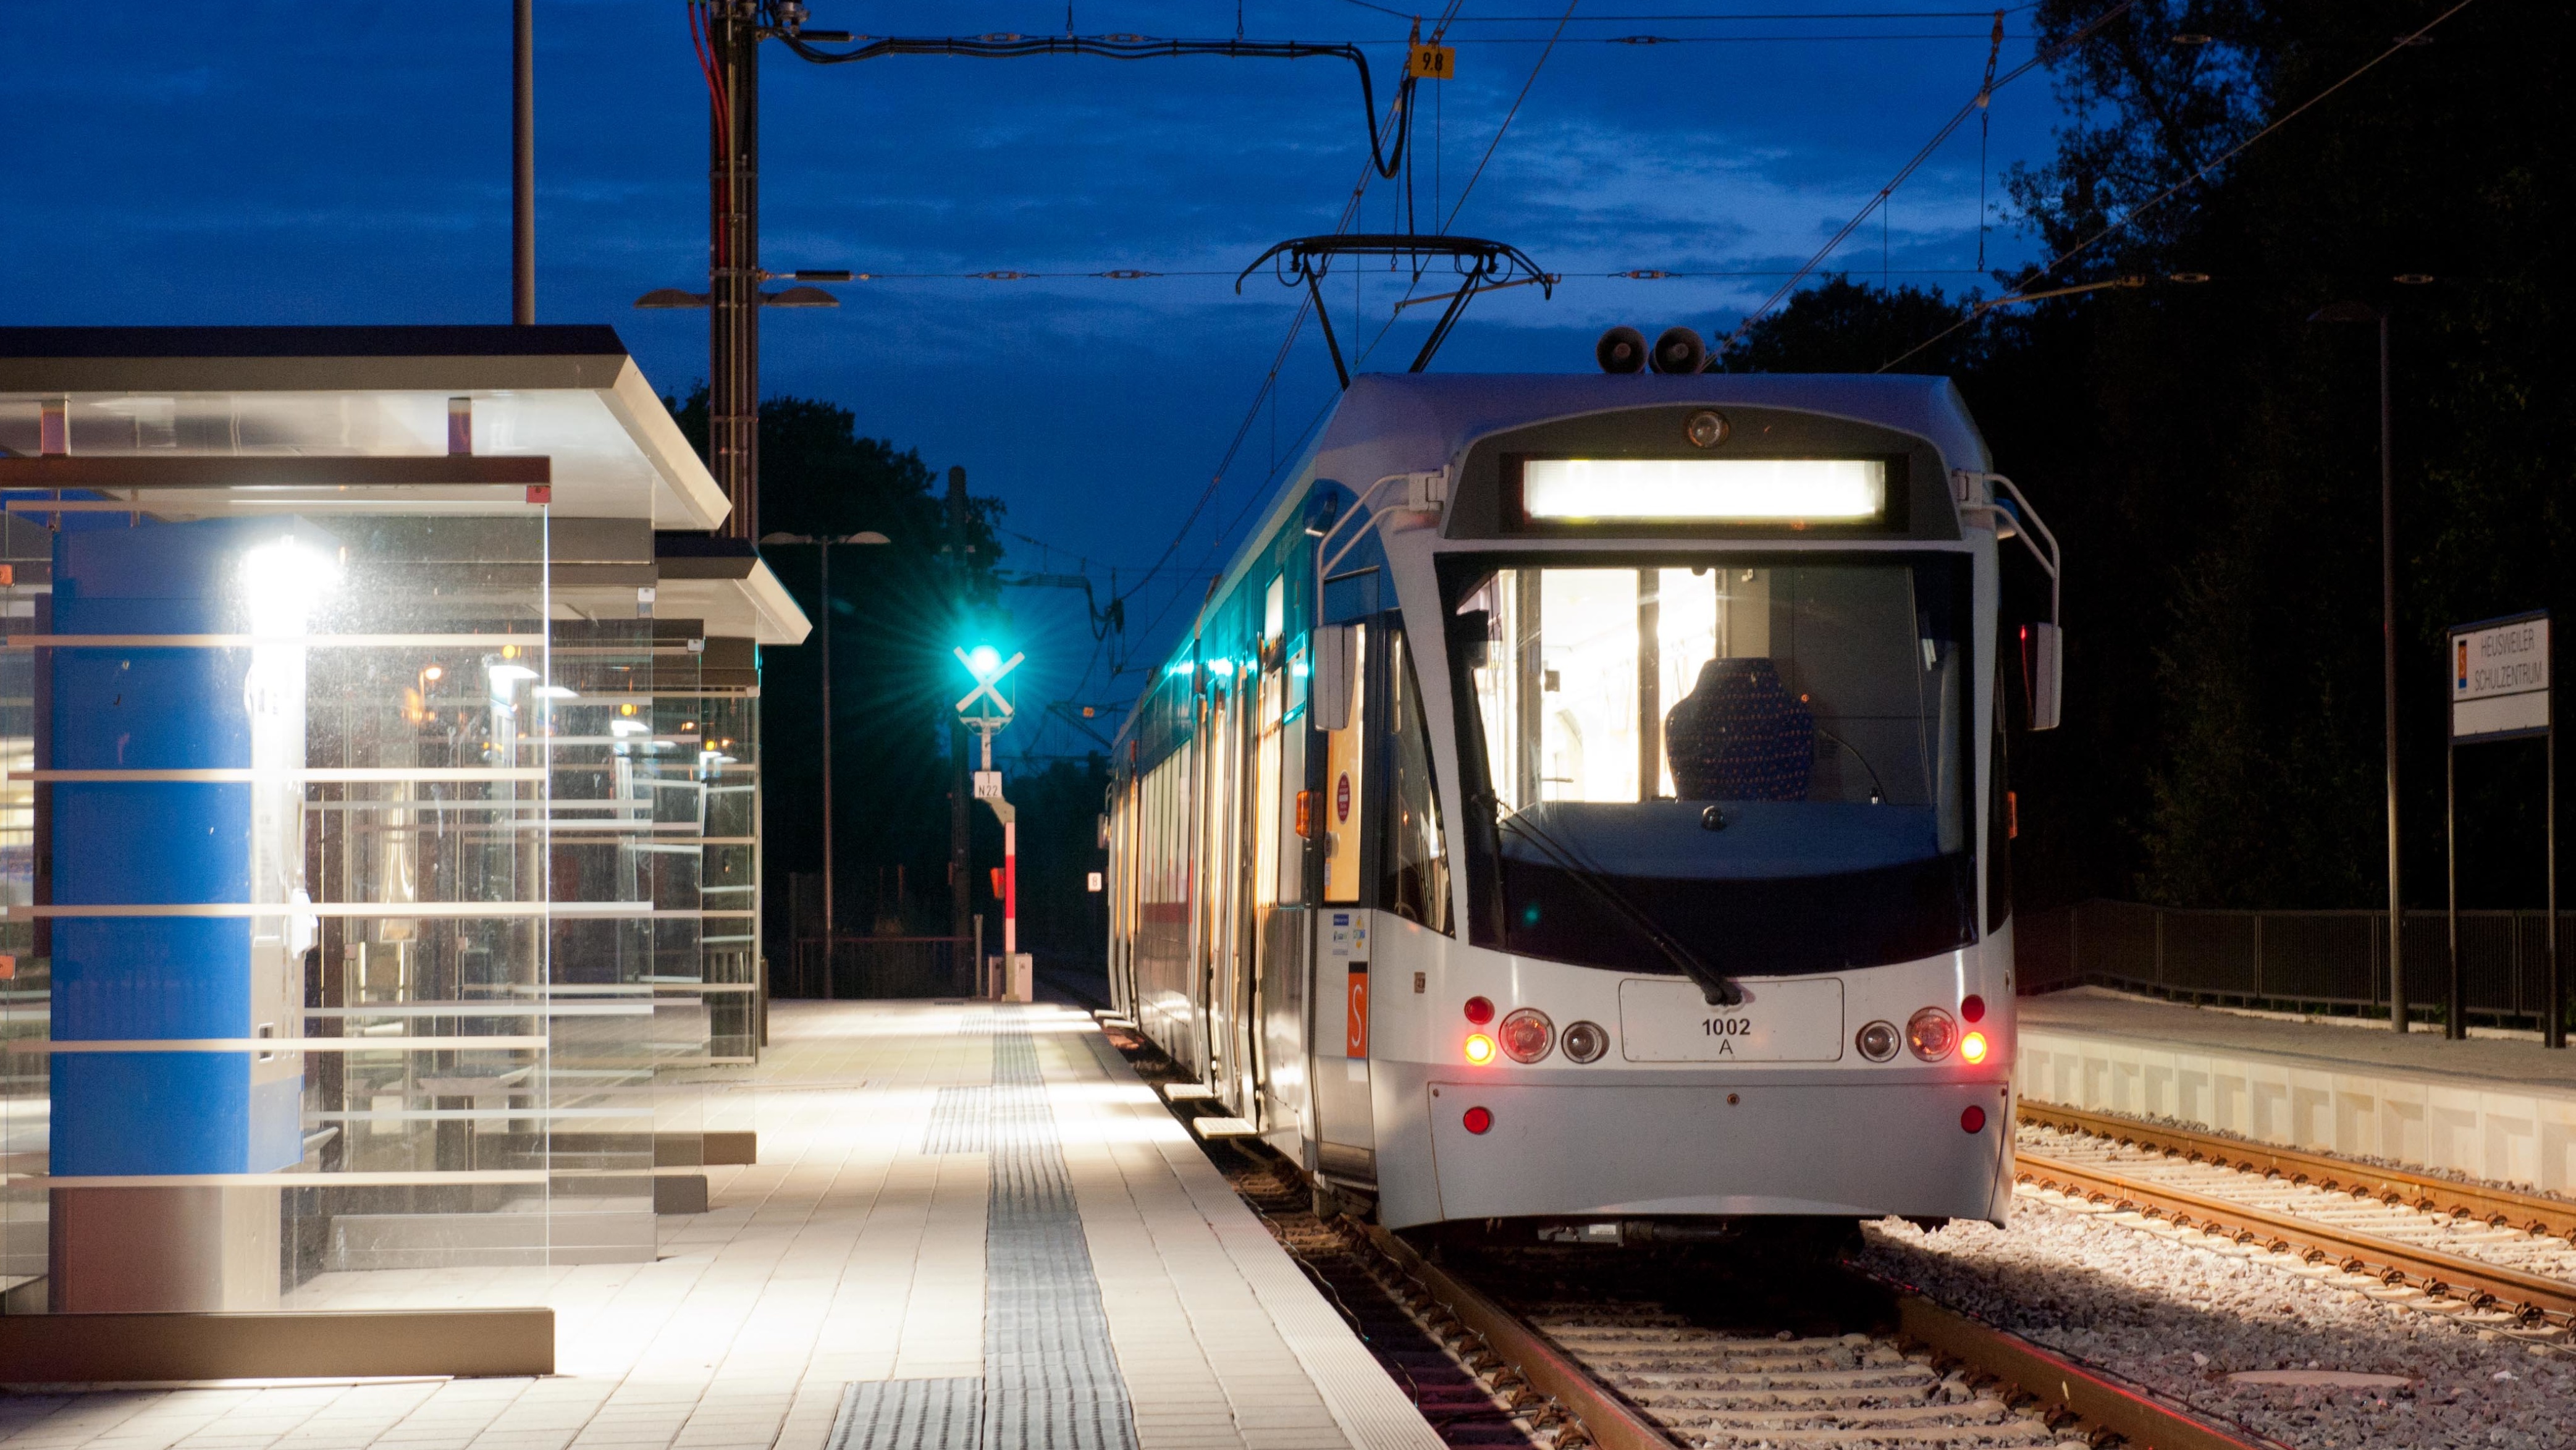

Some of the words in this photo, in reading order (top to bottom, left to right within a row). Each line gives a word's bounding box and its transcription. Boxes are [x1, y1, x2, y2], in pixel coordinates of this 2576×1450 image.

[1423, 52, 1443, 71] 9.8
[2481, 628, 2535, 657] HEUSWEILER
[2475, 660, 2542, 691] SCHULZENTRUM
[979, 785, 998, 796] N22
[1351, 984, 1363, 1047] S
[1702, 1018, 1751, 1035] 1002
[1719, 1039, 1733, 1055] A
